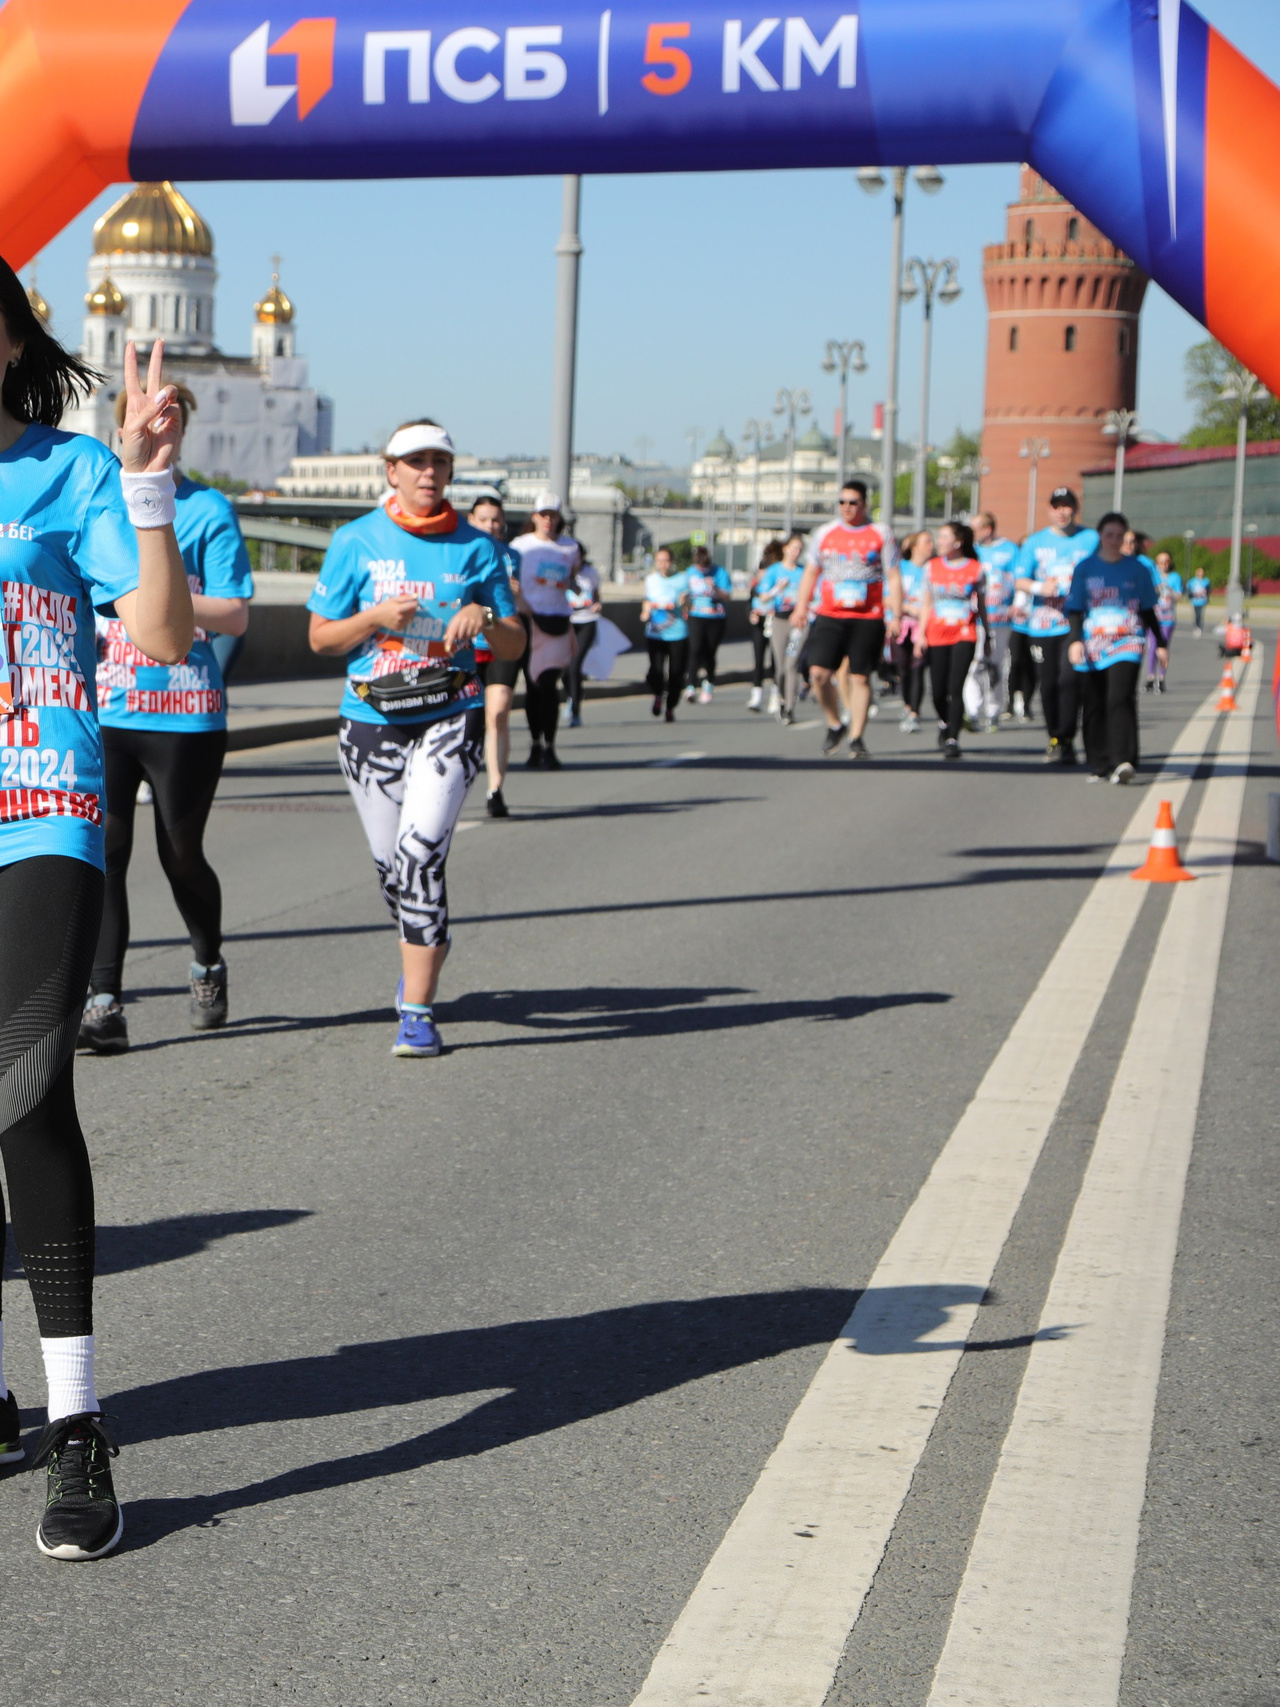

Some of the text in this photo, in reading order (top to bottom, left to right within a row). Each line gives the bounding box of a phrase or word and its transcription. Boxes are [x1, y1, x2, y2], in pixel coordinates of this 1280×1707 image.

[362, 14, 859, 104] ПСБ 5 КМ
[168, 665, 210, 689] 2024
[127, 689, 222, 714] #ЕДИНСТВО
[1, 748, 78, 789] 2024
